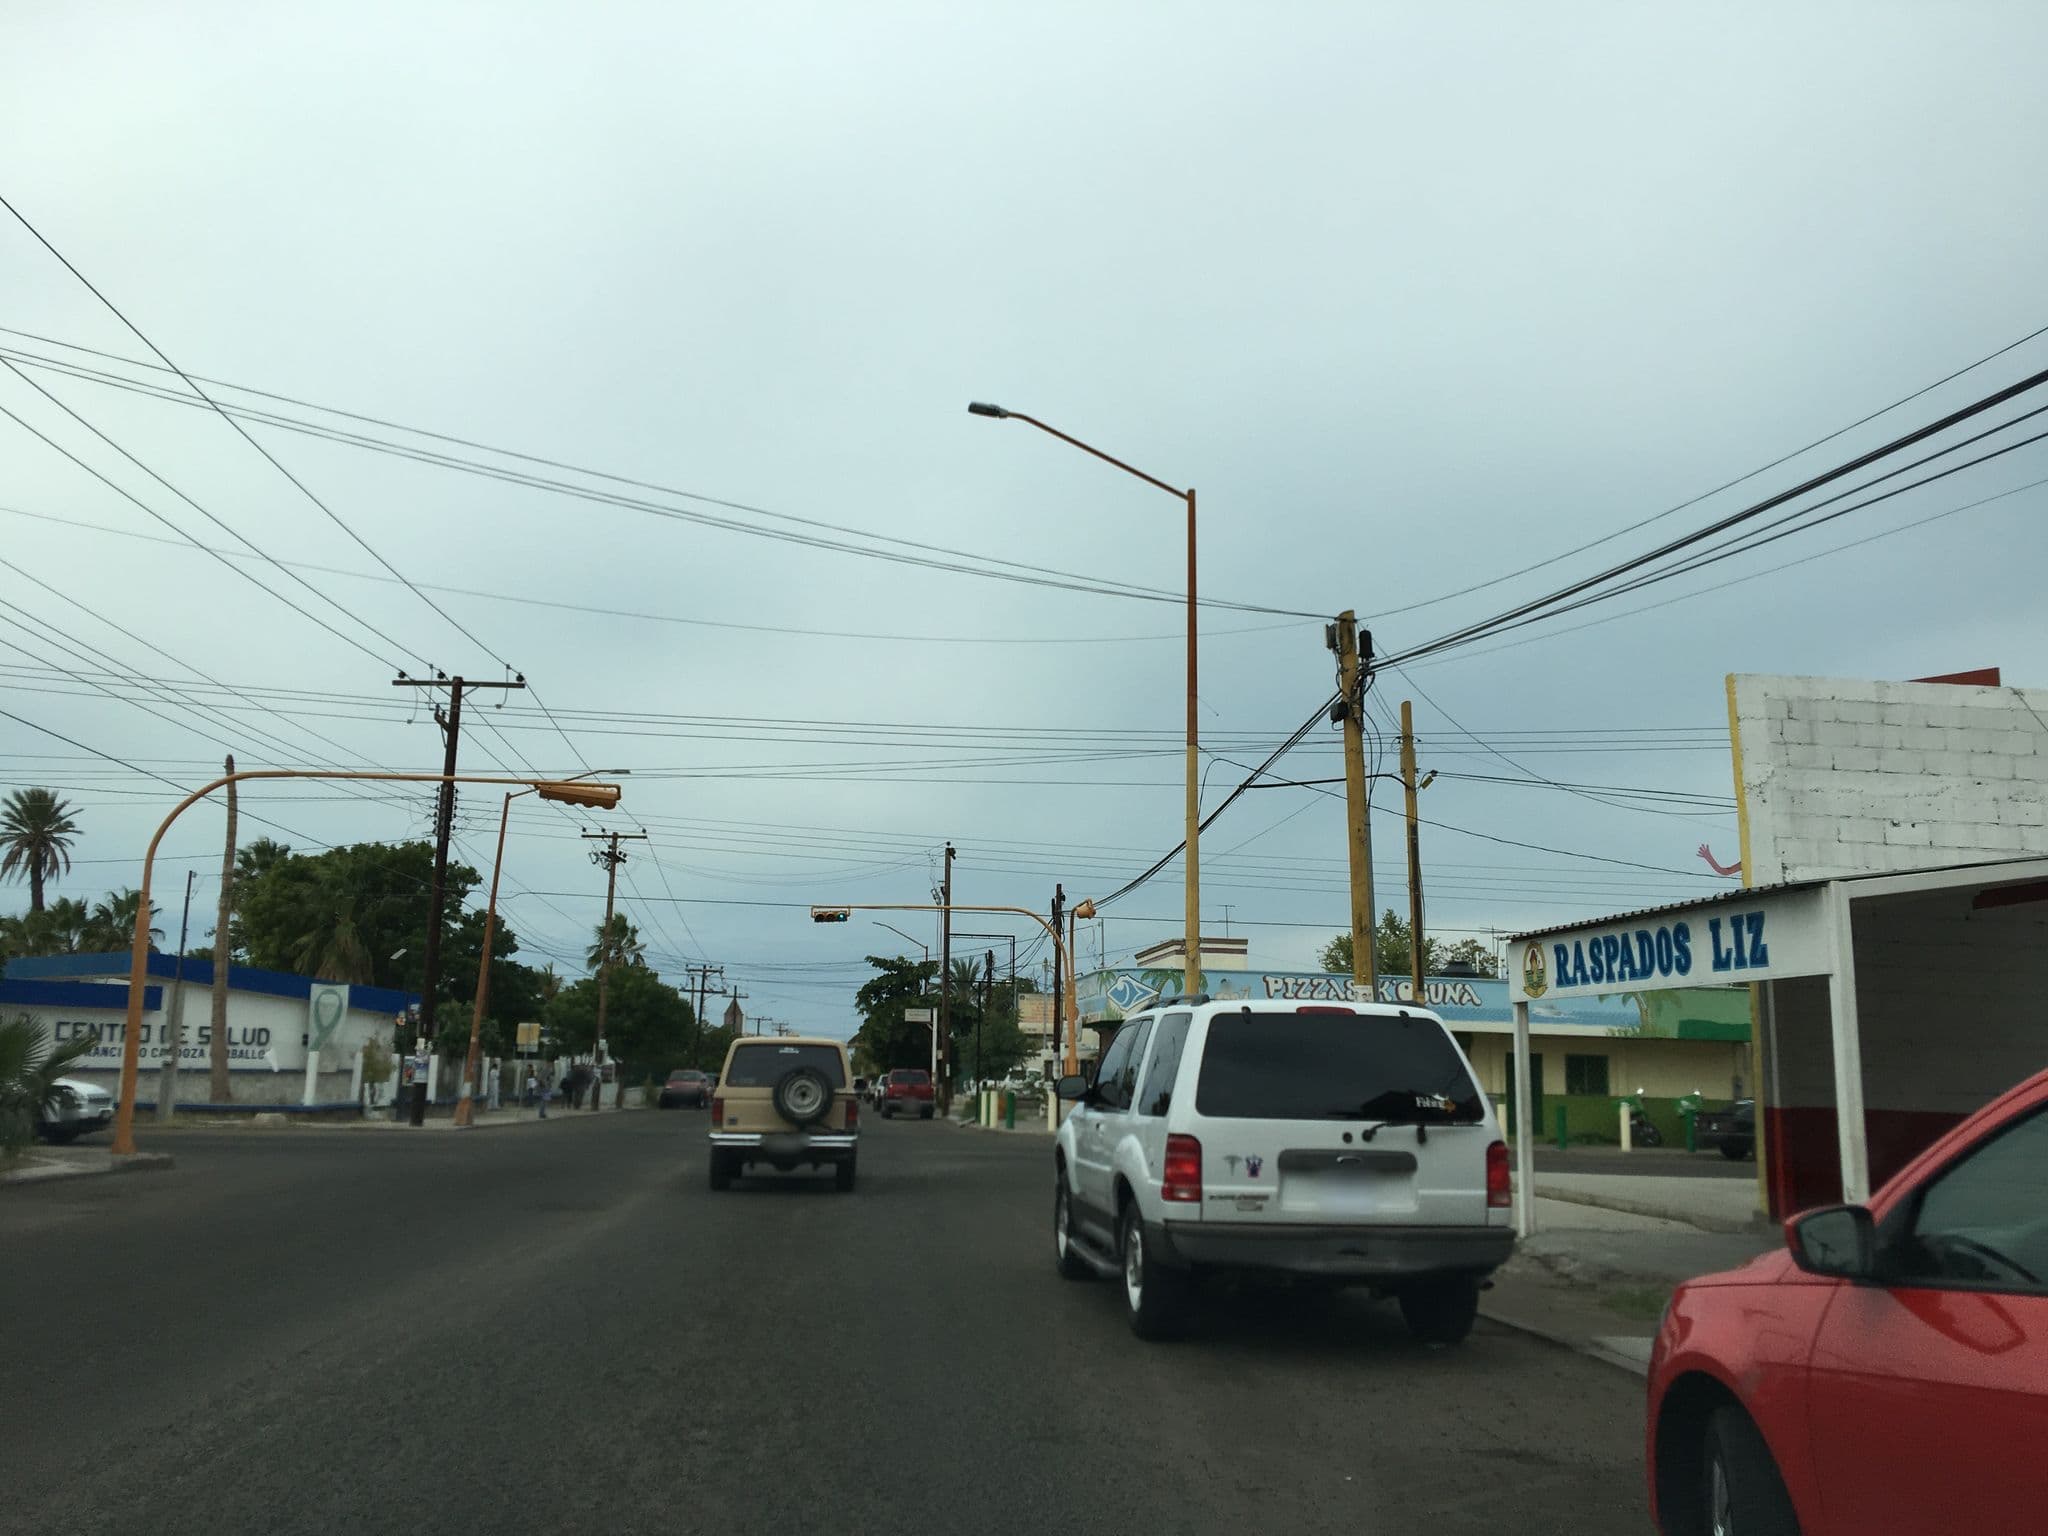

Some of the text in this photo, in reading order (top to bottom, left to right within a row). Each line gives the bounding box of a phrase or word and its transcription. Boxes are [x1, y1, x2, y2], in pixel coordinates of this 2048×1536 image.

[1553, 910, 1769, 988] RASPADOS LIZ
[1263, 976, 1356, 1001] PIZZAS
[198, 1025, 271, 1046] SLUD
[85, 1046, 147, 1058] ANCIO
[150, 1047, 205, 1059] CAOZA
